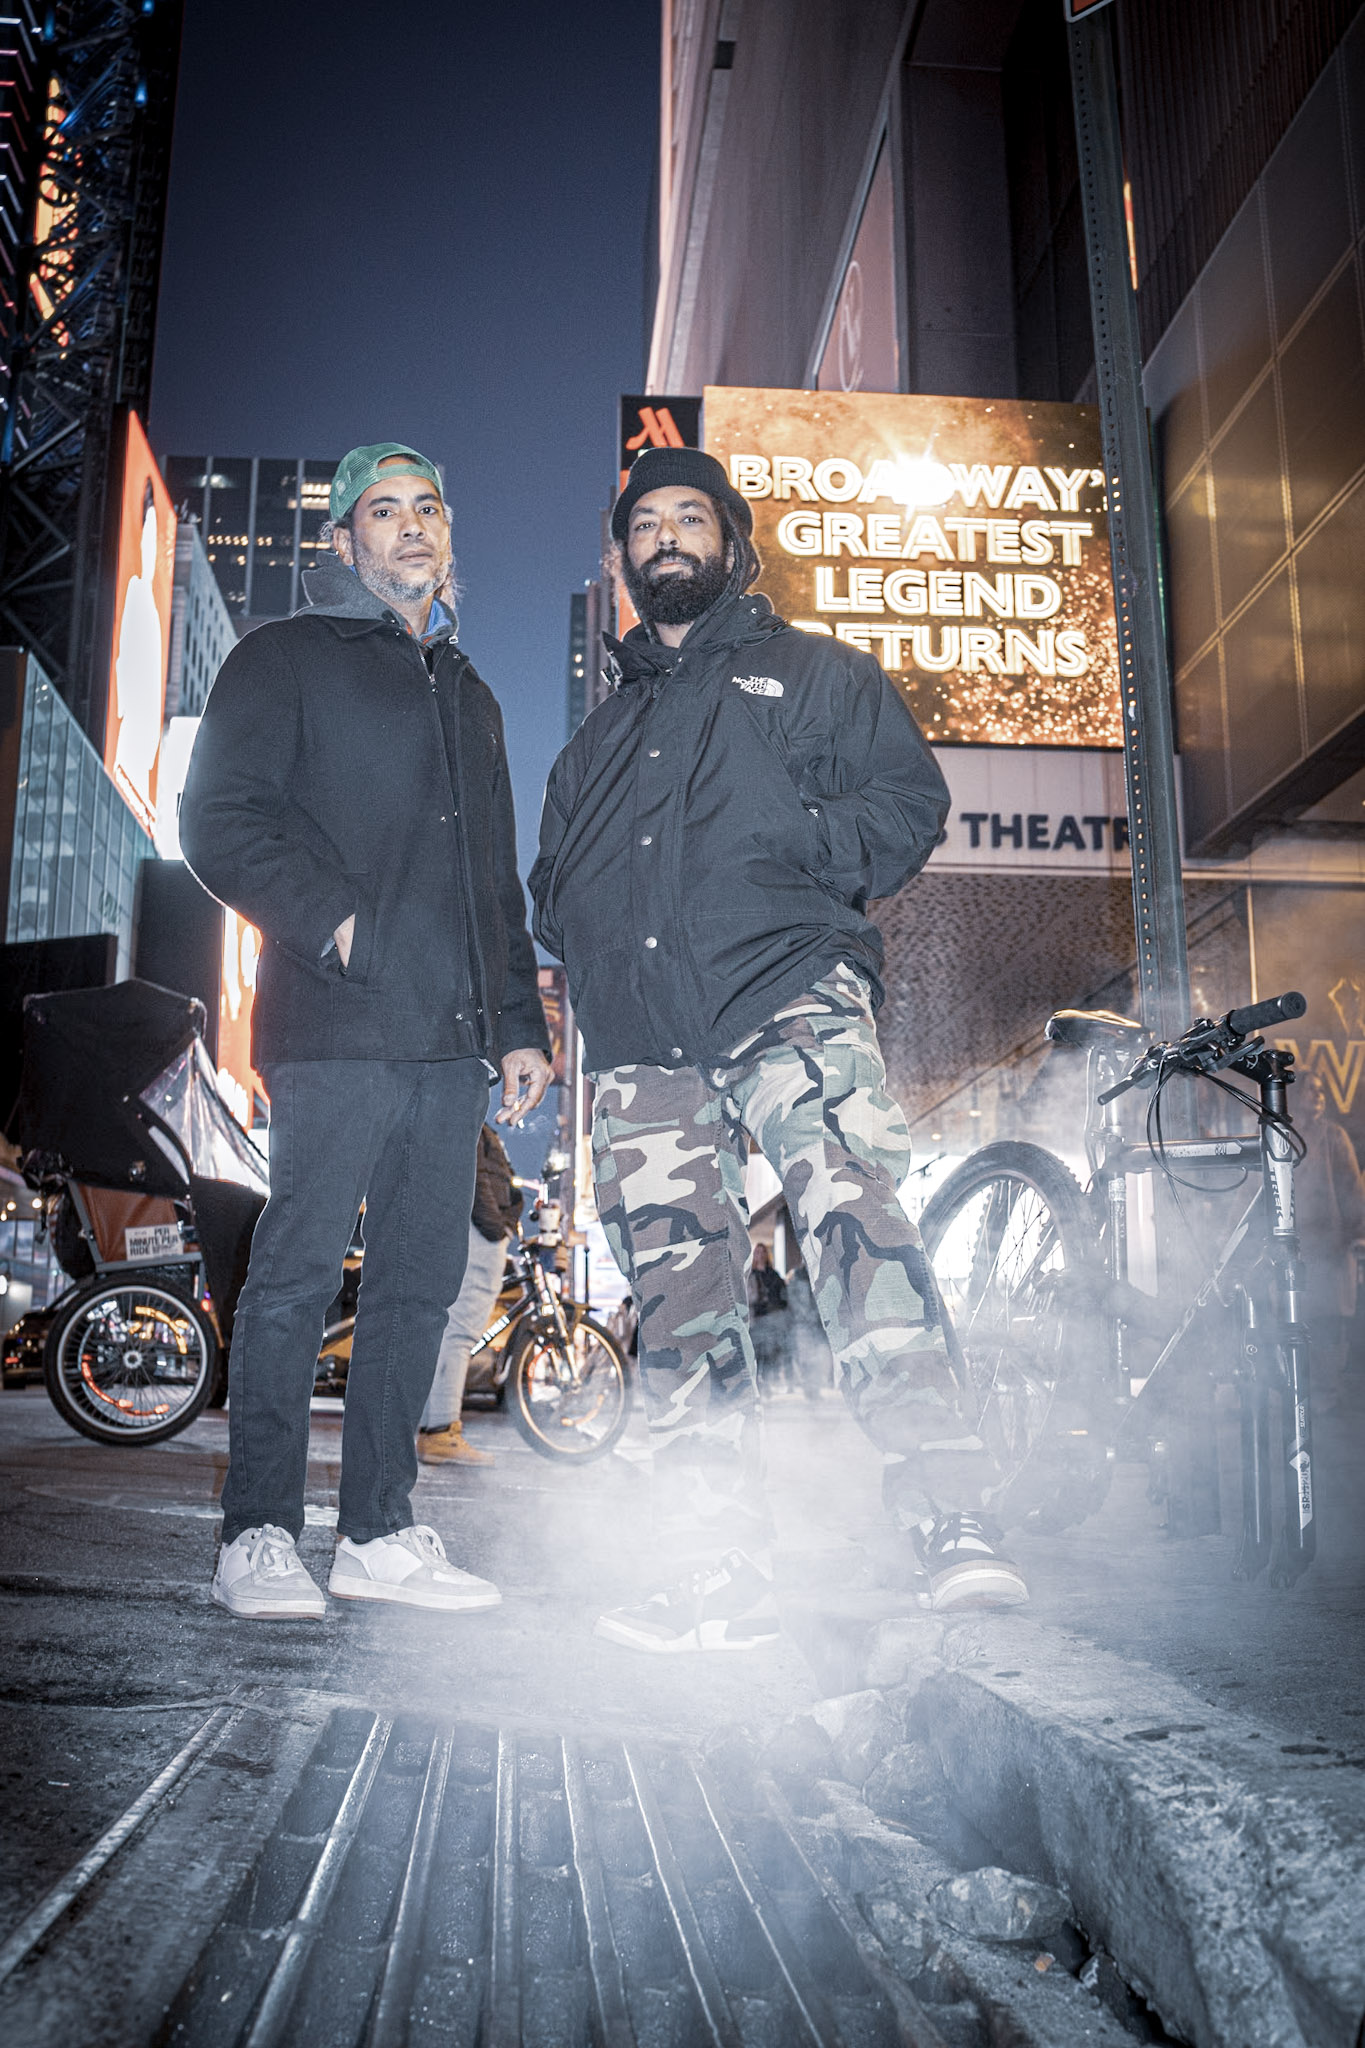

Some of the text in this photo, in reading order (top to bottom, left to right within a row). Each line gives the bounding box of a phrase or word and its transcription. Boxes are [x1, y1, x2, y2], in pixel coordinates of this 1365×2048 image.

[777, 510, 1093, 567] GREATEST
[814, 565, 1062, 621] LEGEND
[790, 619, 1089, 678] ETURNS
[731, 676, 767, 689] NORTH
[749, 675, 767, 684] THE
[740, 684, 767, 696] FACE
[130, 1246, 151, 1256] RIDE
